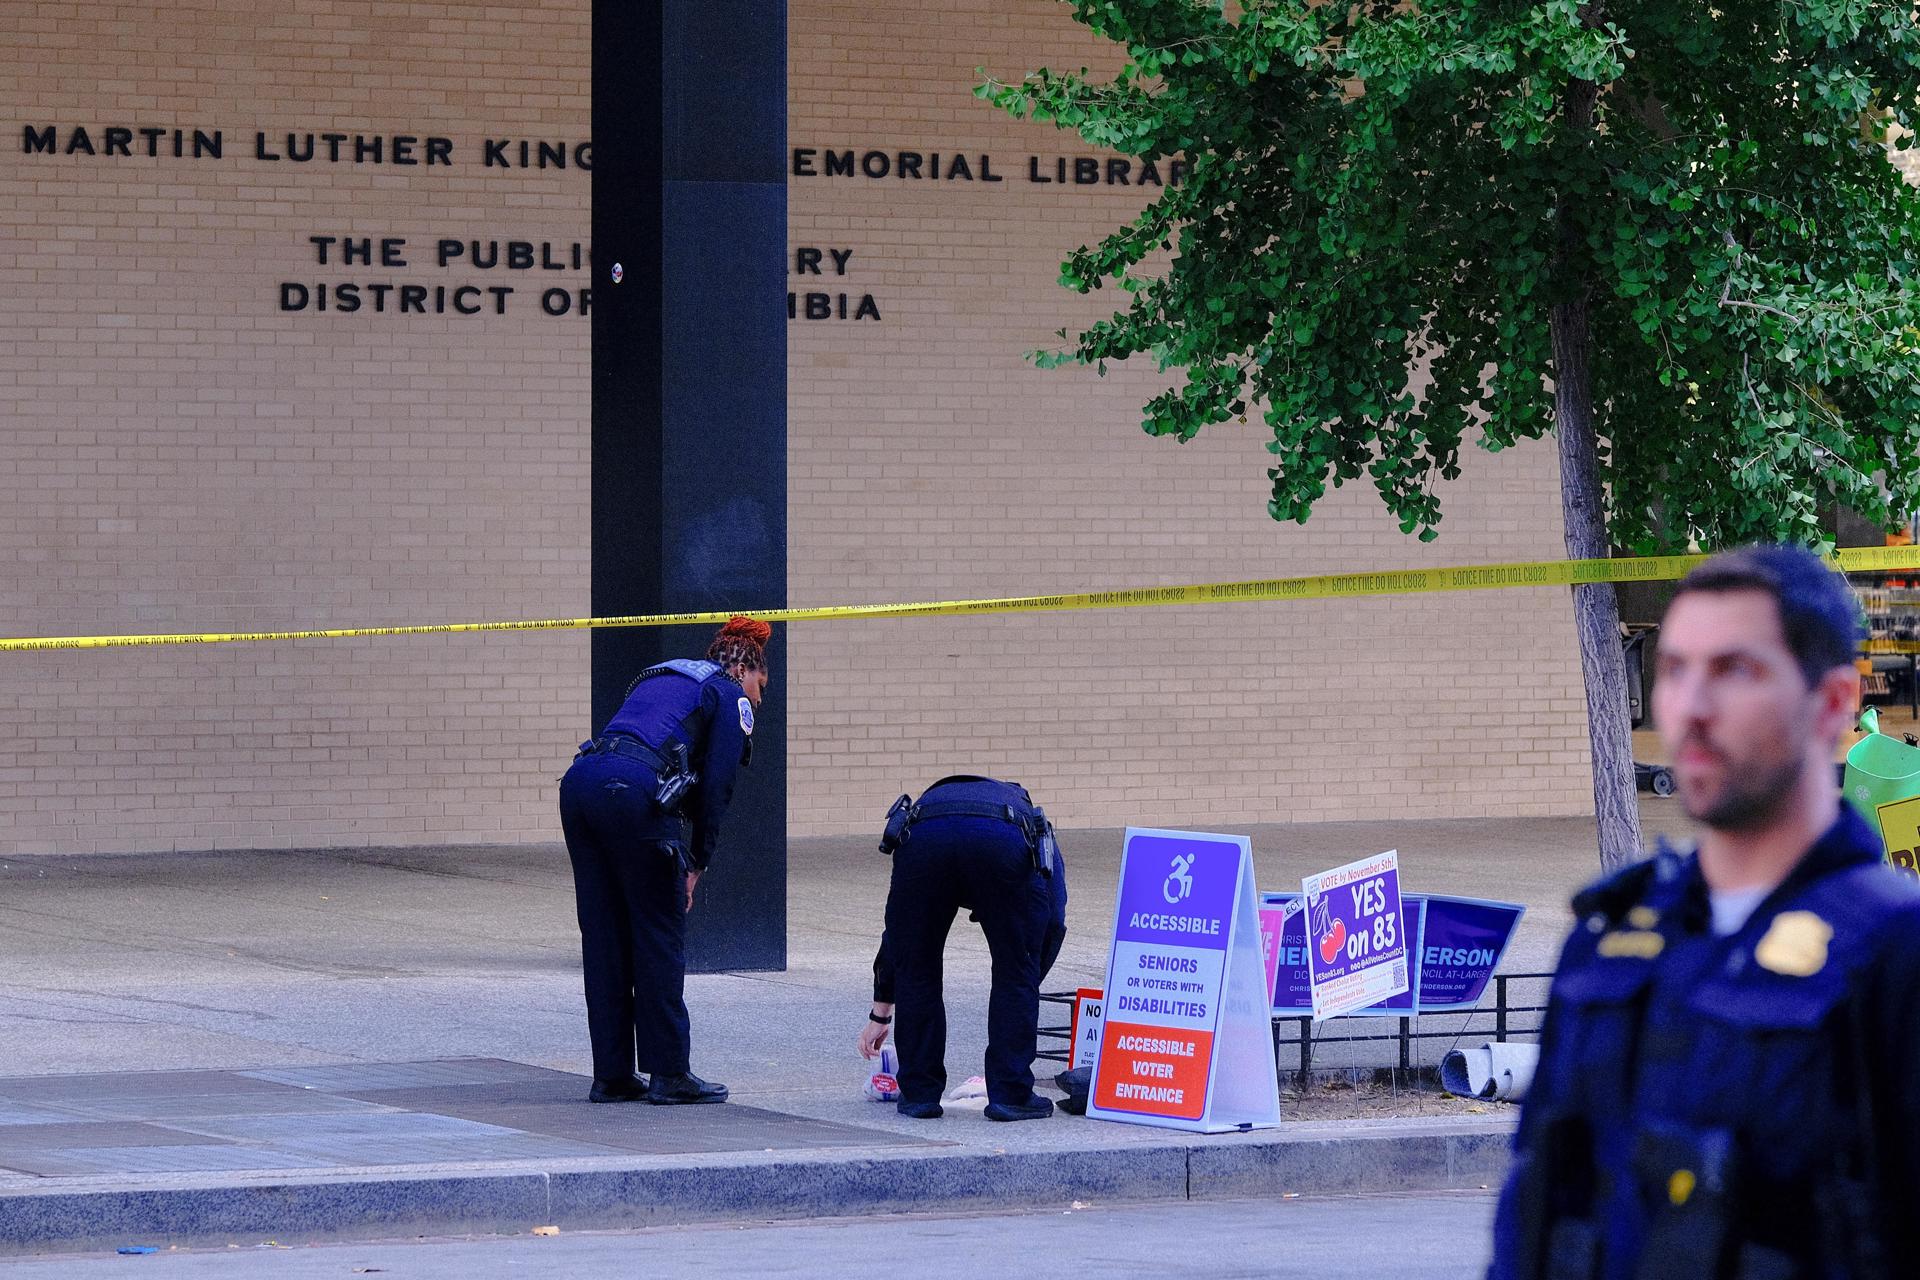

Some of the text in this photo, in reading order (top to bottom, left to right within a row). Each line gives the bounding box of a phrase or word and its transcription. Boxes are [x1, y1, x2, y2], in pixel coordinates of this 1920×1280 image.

[24, 125, 1186, 187] MARTIN LUTHER KING EMORIAL LIBRAR
[310, 236, 407, 267] THE
[439, 240, 591, 270] PUBLI
[281, 282, 514, 315] DISTRICT
[1320, 856, 1394, 889] VOTE by November 5th!
[1285, 899, 1301, 918] ECT
[1351, 877, 1386, 920] YES
[1129, 912, 1221, 935] ACCESSIBLE
[1347, 929, 1369, 960] on
[1372, 911, 1396, 951] 83
[1138, 954, 1198, 974] SENIORS
[1422, 946, 1495, 967] ERSON
[1421, 968, 1488, 980] NCIL AT-LARGE
[1127, 977, 1204, 994] OR VOTERS WITH
[1118, 995, 1207, 1018] DISABILITIES
[1117, 1035, 1195, 1057] ACCESSIBLE
[1132, 1060, 1174, 1079] VOTER
[1115, 1082, 1184, 1104] ENTRANCE
